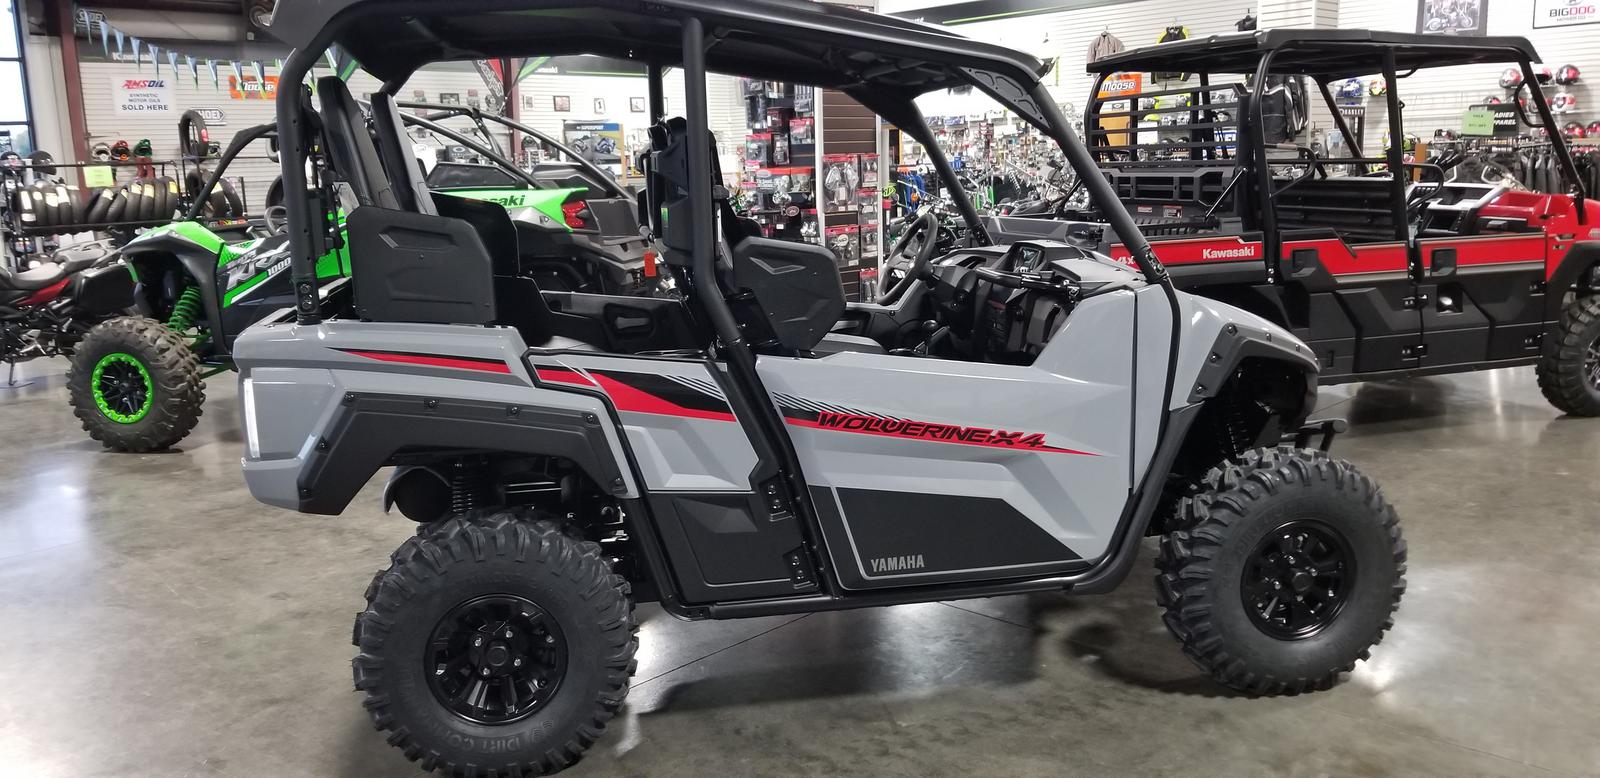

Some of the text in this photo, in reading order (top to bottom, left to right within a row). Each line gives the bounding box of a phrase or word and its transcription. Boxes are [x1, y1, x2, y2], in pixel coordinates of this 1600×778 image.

[78, 10, 103, 21] SOEI
[122, 80, 165, 89] AMSOIL
[1101, 80, 1136, 91] Moose
[198, 111, 221, 119] HOEI
[1202, 246, 1255, 260] Kawasaki
[267, 256, 292, 276] 1000
[817, 410, 994, 444] WOLVERINE
[870, 554, 925, 573] YAMAHA
